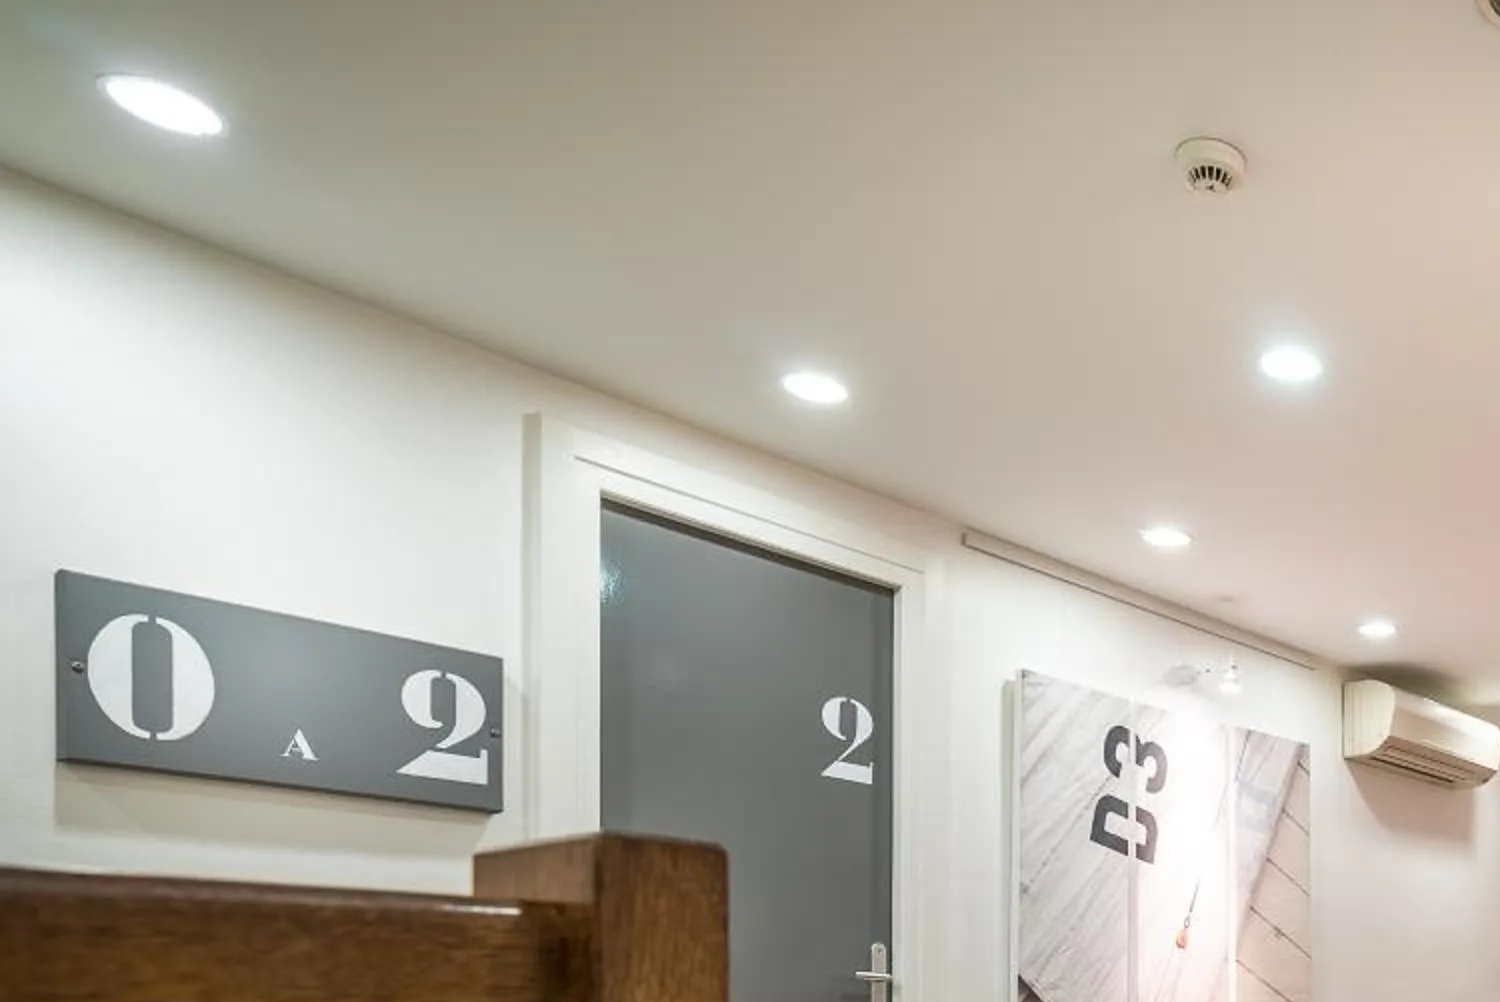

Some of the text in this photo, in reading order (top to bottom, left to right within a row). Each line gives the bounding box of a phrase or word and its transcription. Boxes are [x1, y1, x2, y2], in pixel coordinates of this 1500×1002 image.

[280, 728, 319, 761] A
[395, 669, 488, 785] 2
[821, 696, 874, 785] 2
